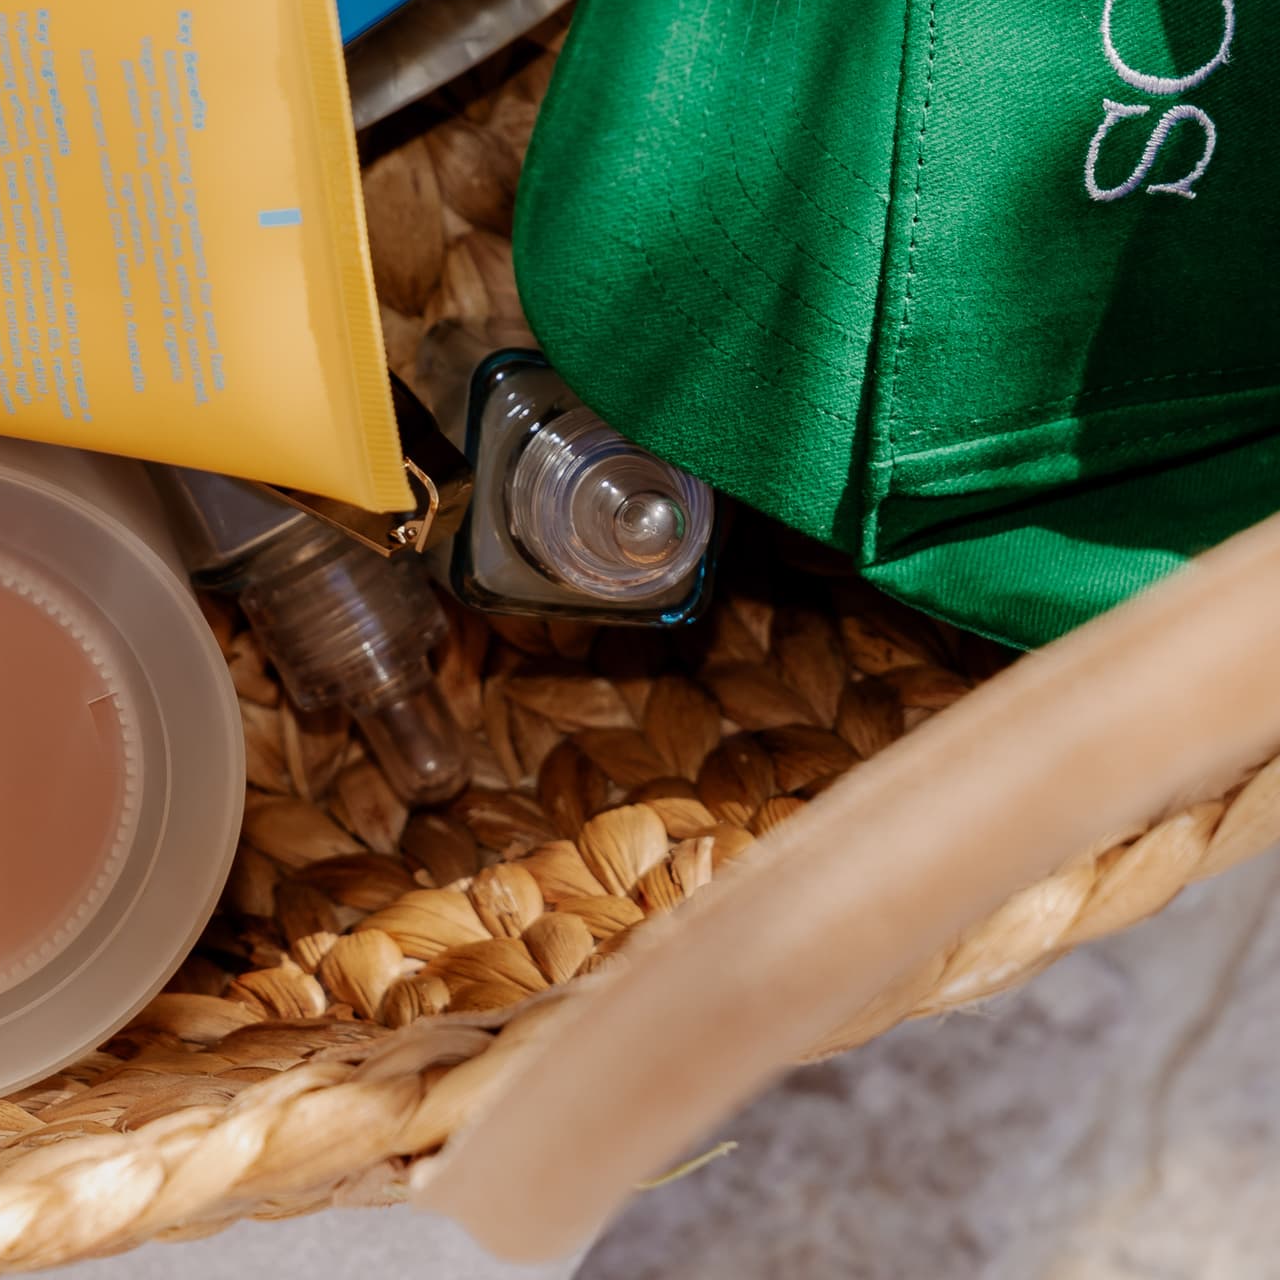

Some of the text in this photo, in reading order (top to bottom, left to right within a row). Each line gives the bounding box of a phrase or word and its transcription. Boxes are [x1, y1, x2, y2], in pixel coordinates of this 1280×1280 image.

[34, 8, 71, 156] Key Ingredients
[176, 9, 206, 131] Key Benefits
